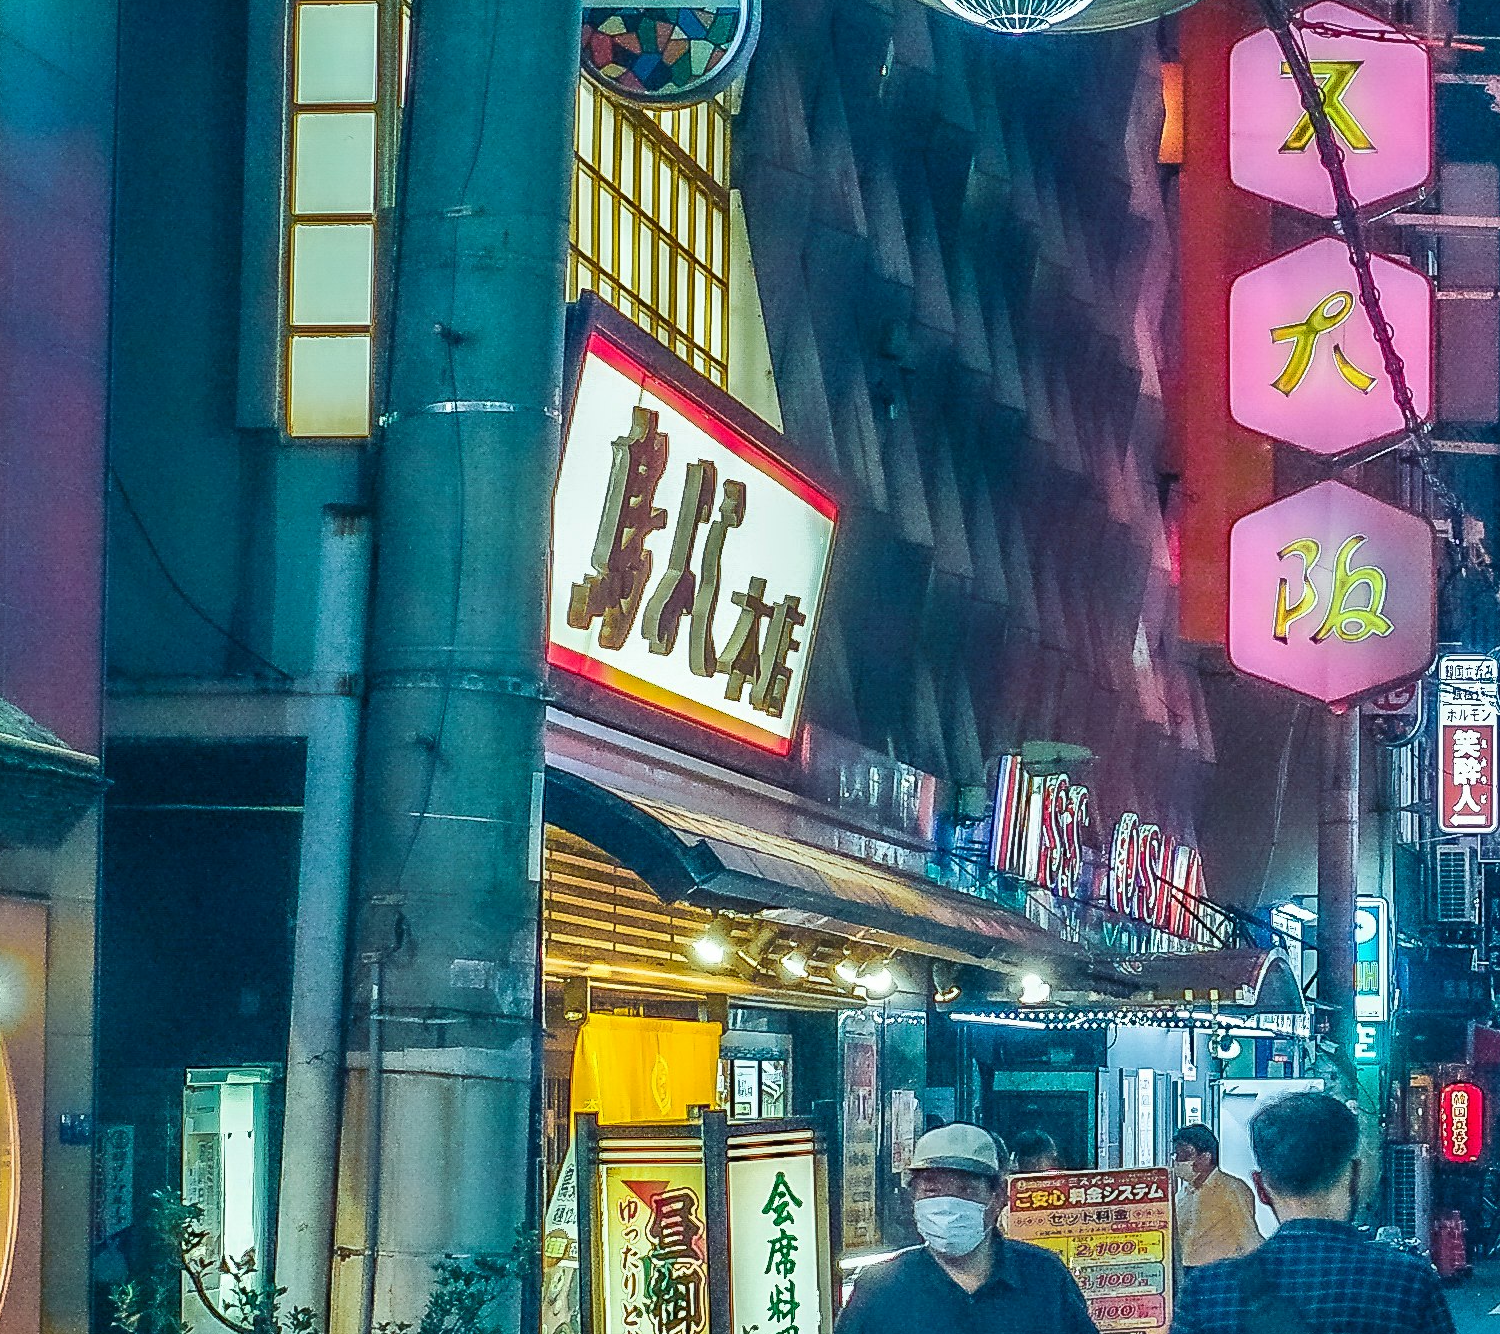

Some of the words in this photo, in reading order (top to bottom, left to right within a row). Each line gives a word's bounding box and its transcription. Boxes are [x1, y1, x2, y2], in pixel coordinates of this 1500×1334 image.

[1447, 709, 1492, 722] ホルモン
[1015, 1189, 1065, 1208] ご安心
[1068, 1183, 1164, 1204] 料金システム
[1048, 1207, 1130, 1226] セット料金
